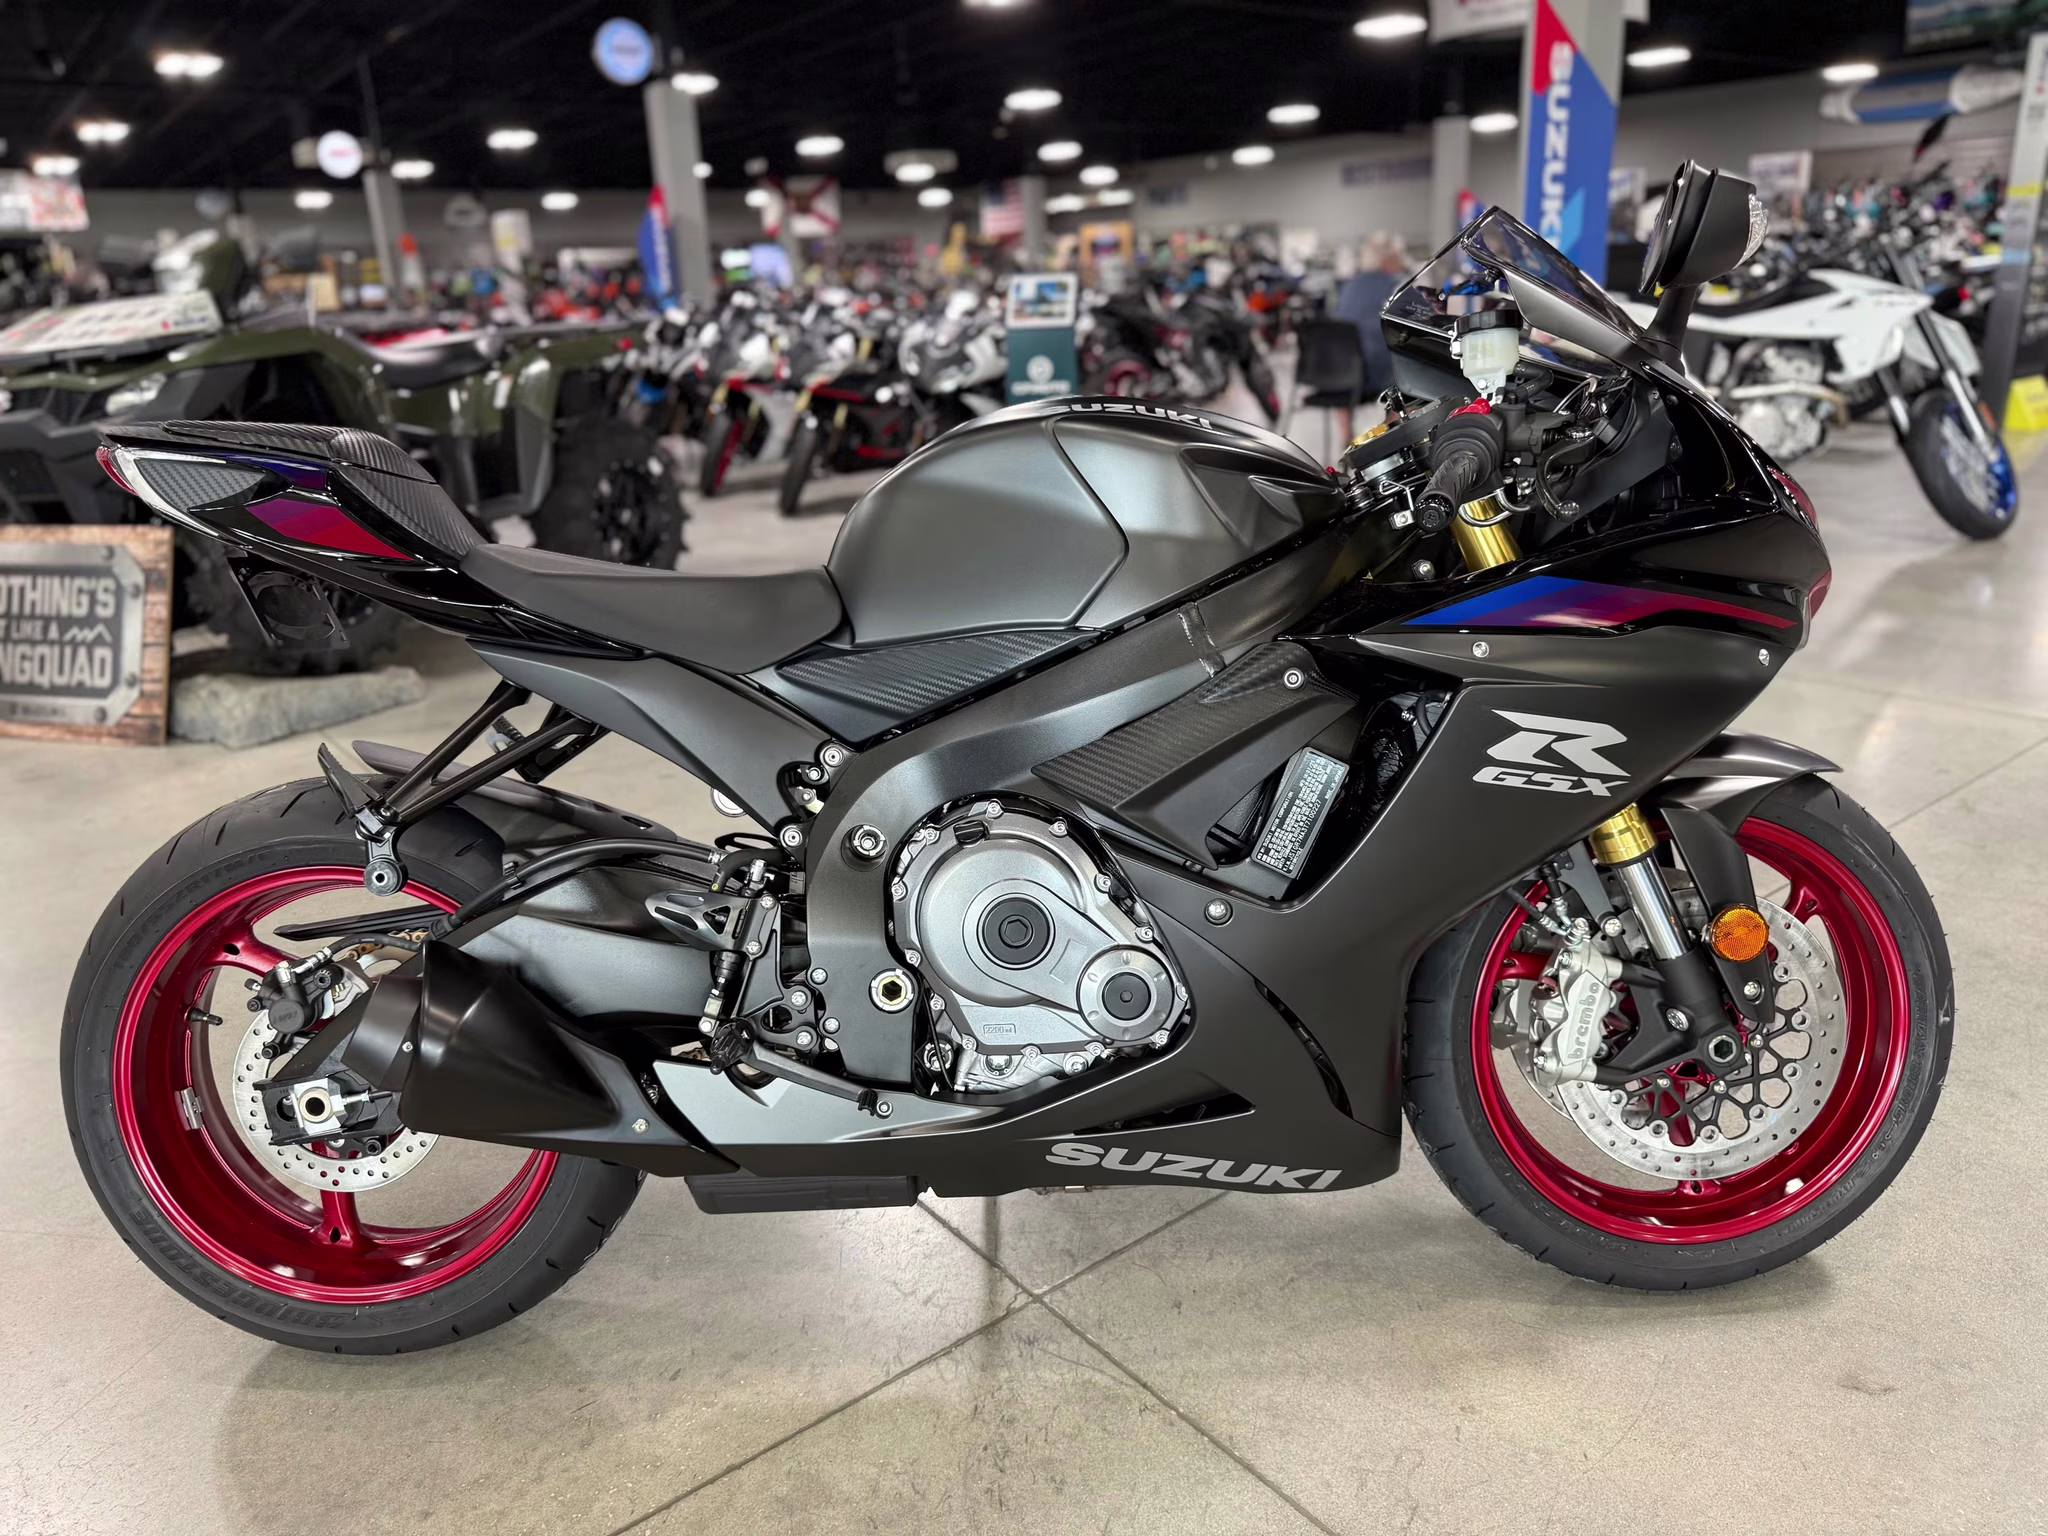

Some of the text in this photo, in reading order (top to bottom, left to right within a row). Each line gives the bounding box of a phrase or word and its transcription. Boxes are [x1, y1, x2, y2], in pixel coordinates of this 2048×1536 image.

[1038, 403, 1213, 430] SUZUKI
[0, 575, 116, 619] OTHING'S
[0, 642, 113, 689] NGQUAD
[1486, 709, 1632, 777] R
[1472, 766, 1630, 796] GSX
[1567, 982, 1600, 1059] brembo
[1045, 1142, 1343, 1190] SUZUKI
